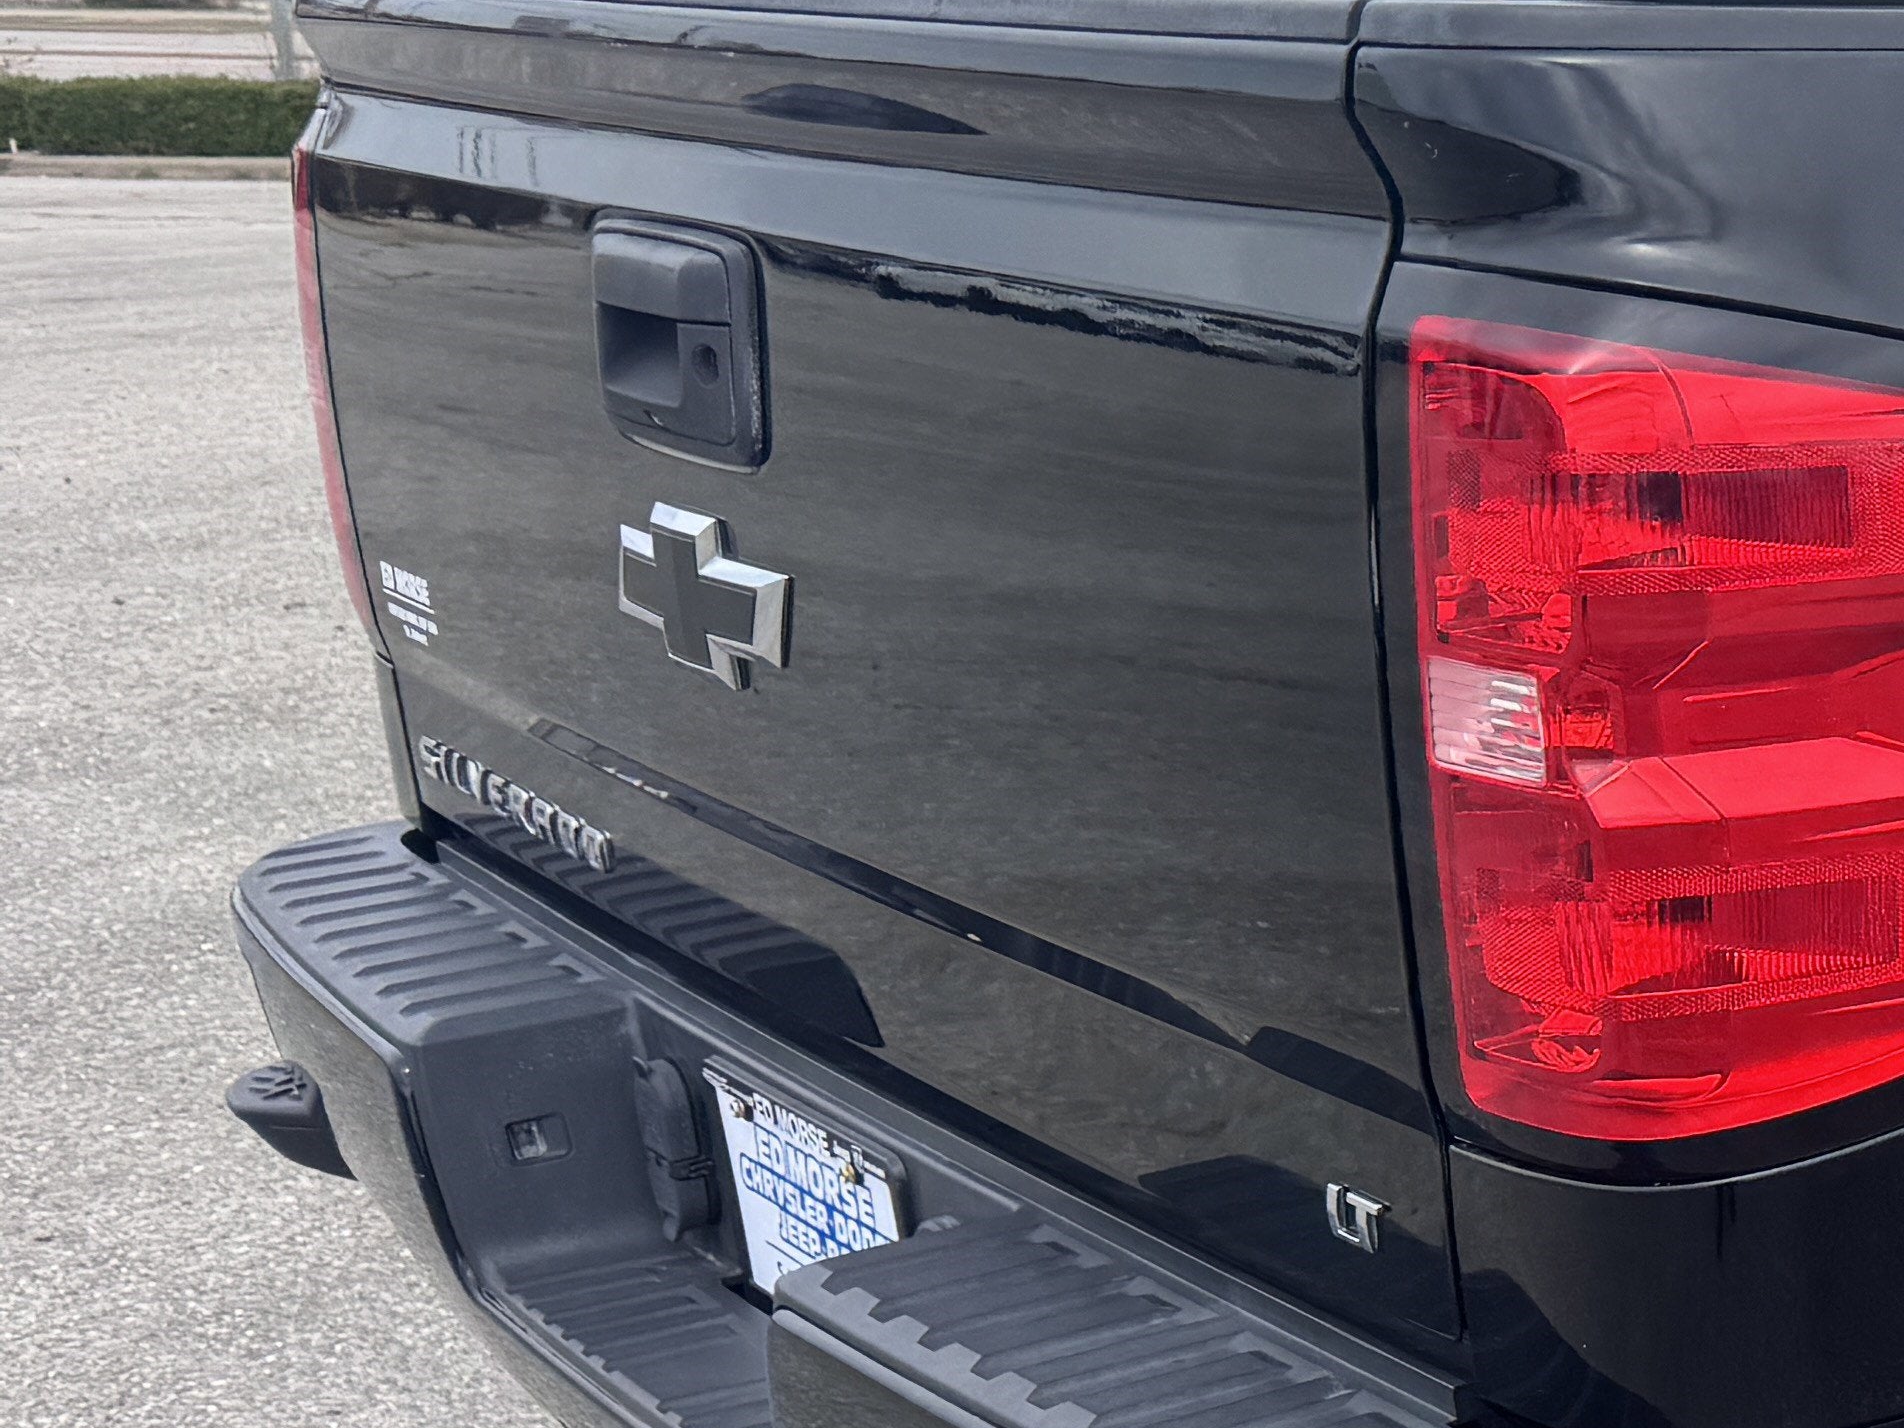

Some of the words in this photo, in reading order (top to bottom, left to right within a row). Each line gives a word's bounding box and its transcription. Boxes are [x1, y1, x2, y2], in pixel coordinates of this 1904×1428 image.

[419, 734, 612, 873] SILVERADO
[773, 1104, 832, 1159] MORSE
[785, 1142, 876, 1232] MORSE
[1326, 1182, 1391, 1254] LT
